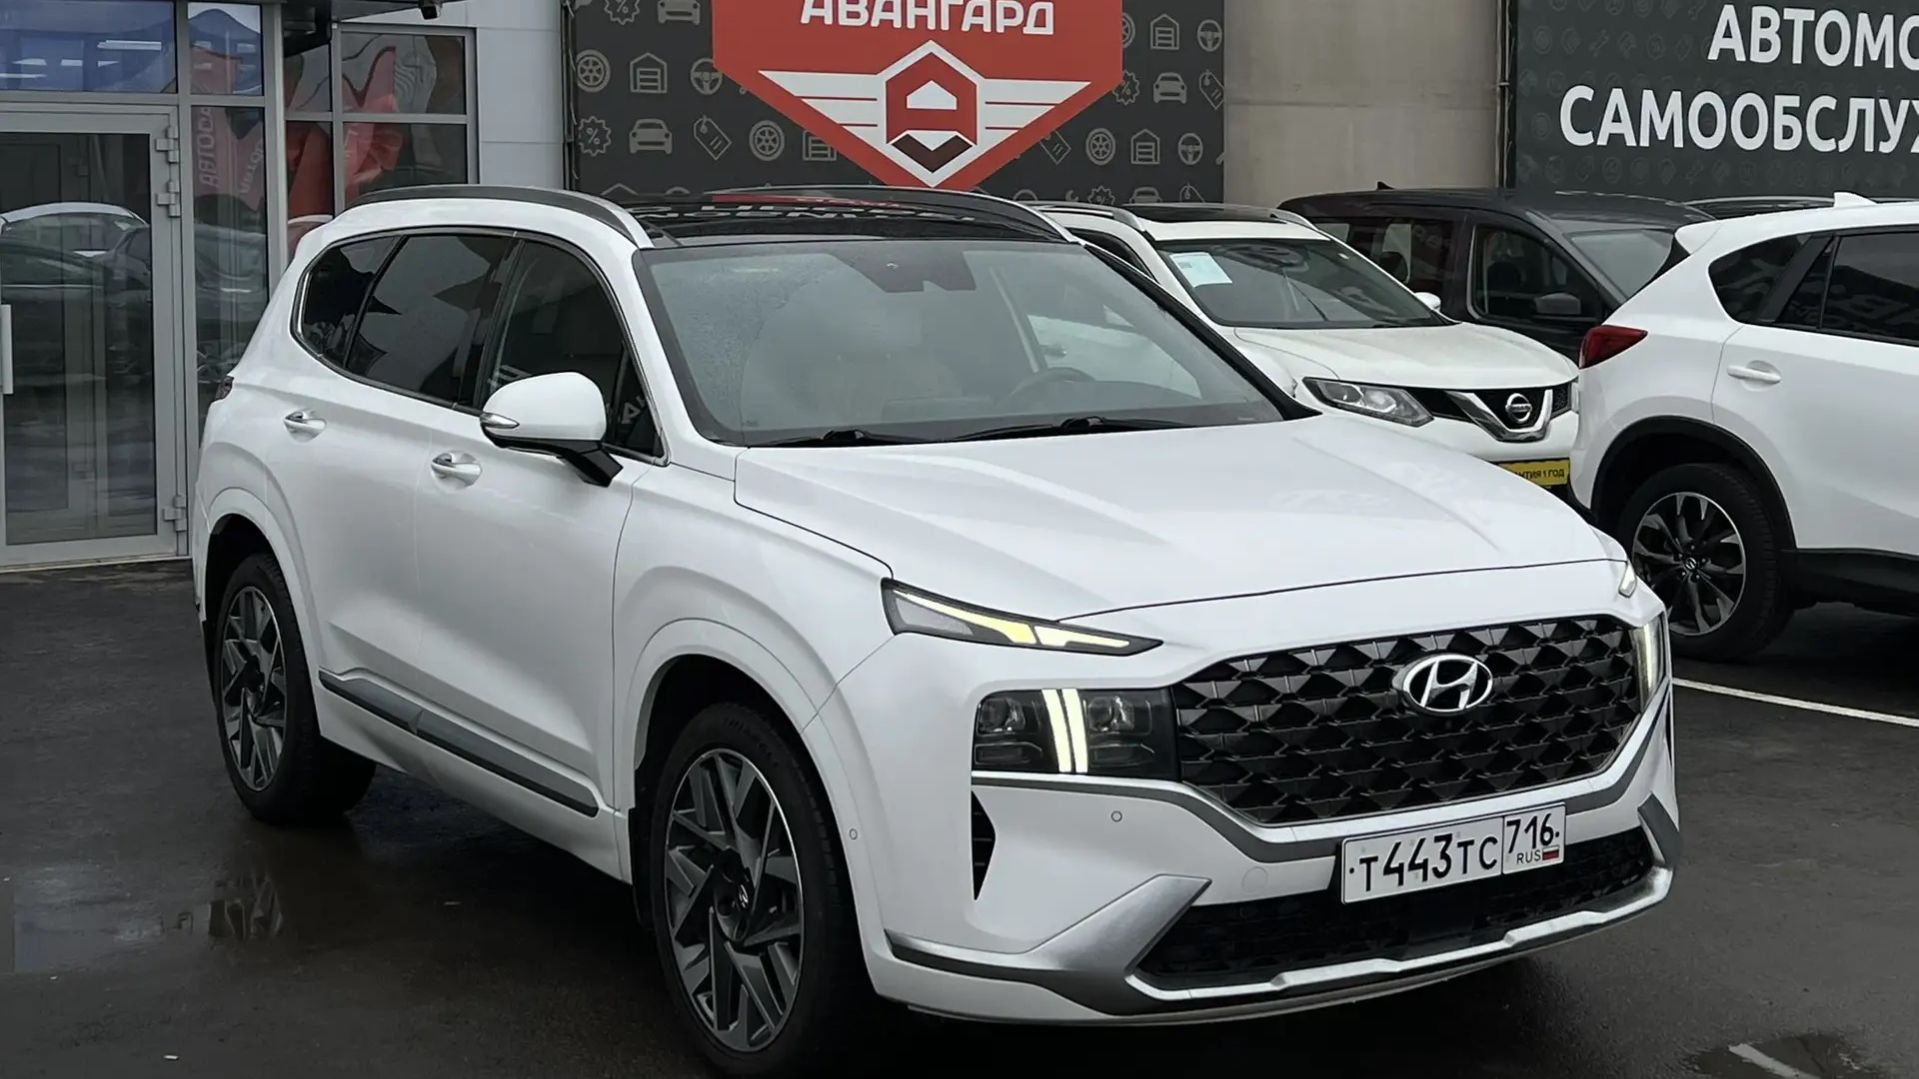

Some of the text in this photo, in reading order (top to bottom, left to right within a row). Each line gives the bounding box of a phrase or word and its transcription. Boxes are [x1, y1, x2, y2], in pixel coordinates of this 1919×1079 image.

[801, 0, 1054, 35] АВАНГАРД
[1560, 85, 1919, 153] САМООБСЛУ
[1359, 813, 1554, 892] Т443ТС 716
[1516, 849, 1541, 865] RUS
